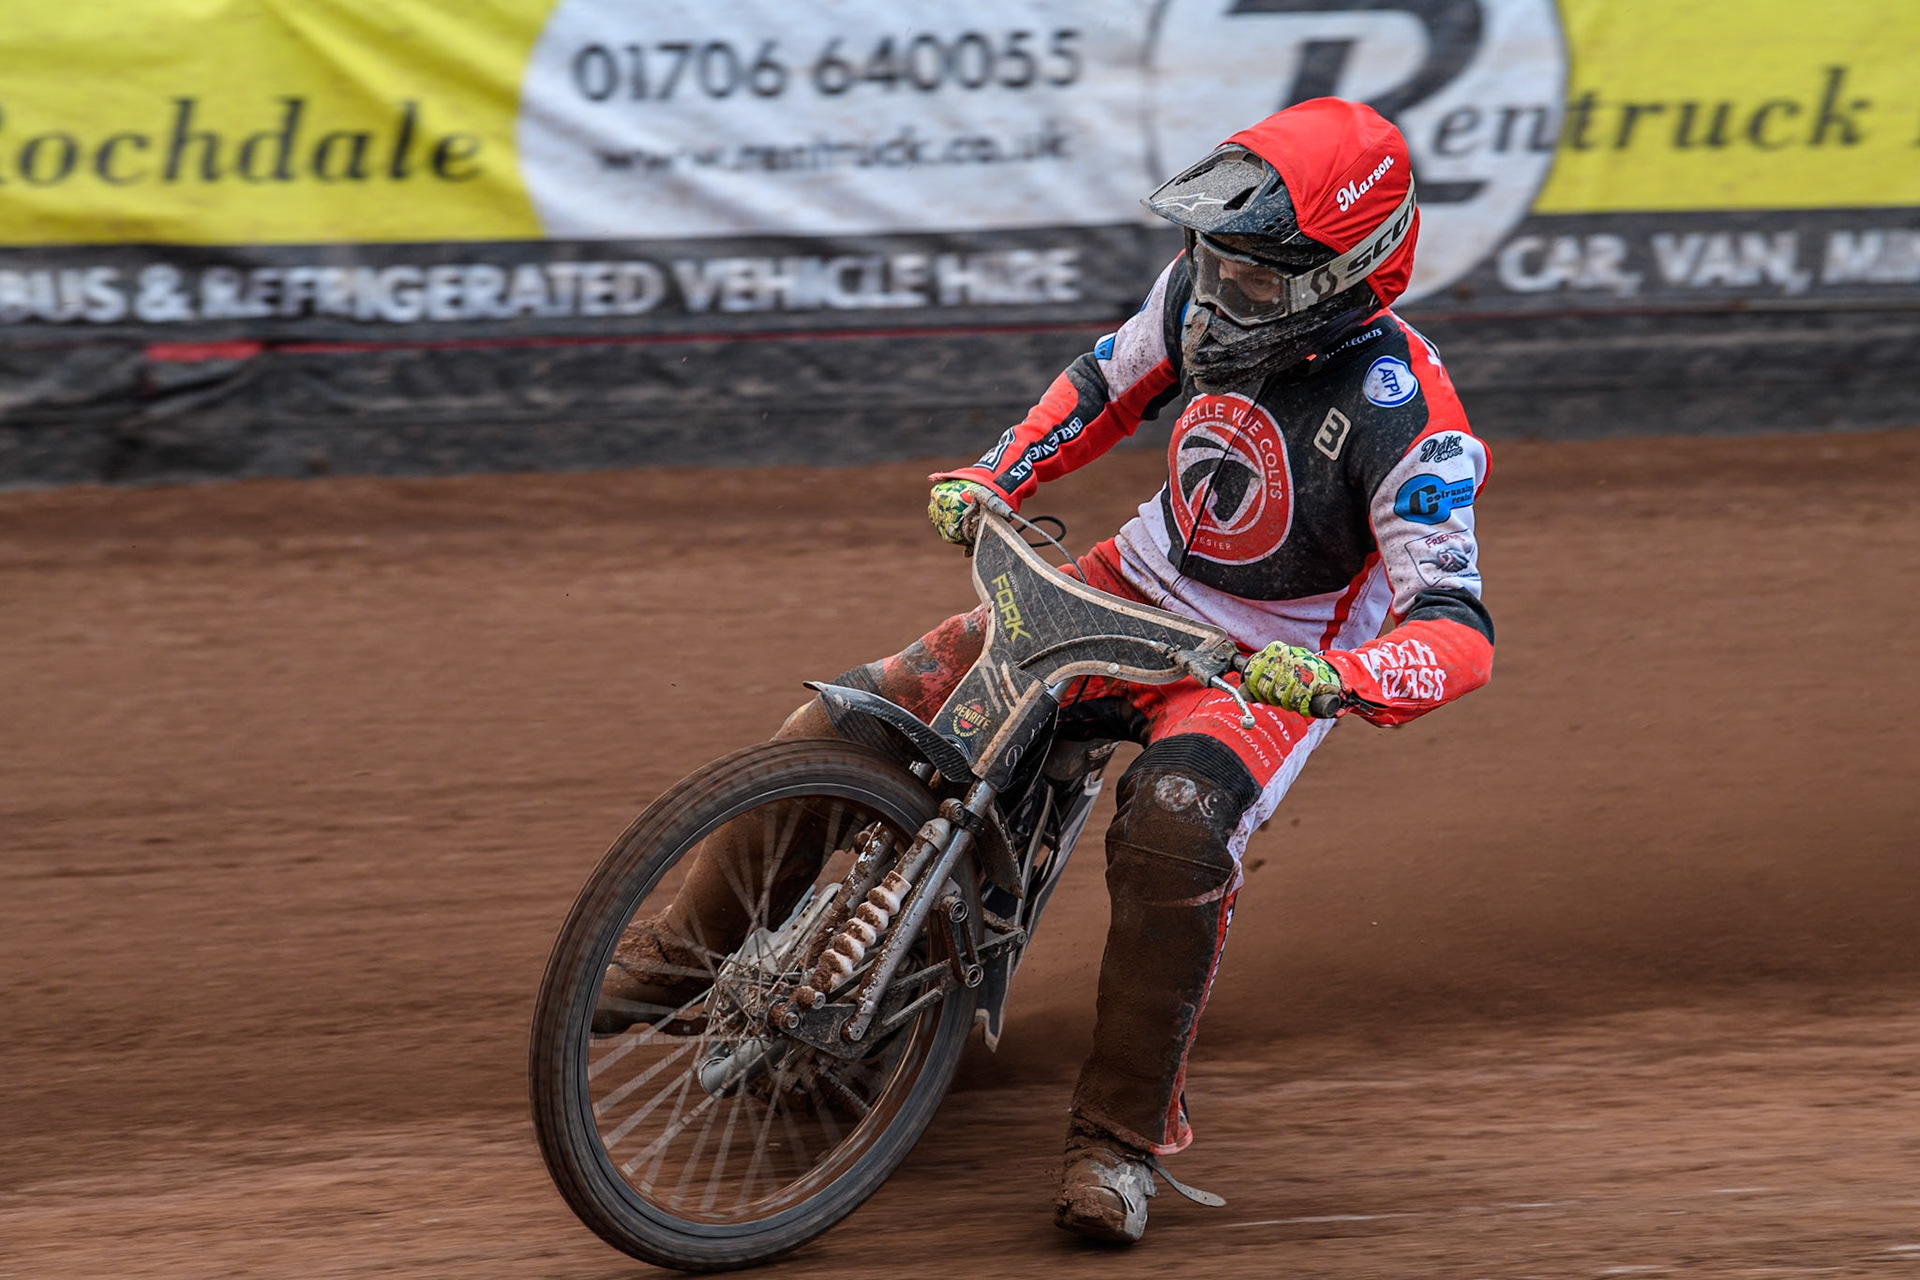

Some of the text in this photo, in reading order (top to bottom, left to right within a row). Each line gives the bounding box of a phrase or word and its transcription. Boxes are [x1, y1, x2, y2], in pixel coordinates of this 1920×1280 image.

[572, 30, 1084, 101] 01706 640055
[0, 96, 482, 187] ochdale
[1336, 155, 1395, 212] Marson
[135, 263, 192, 322] &
[202, 259, 664, 320] REFRIGERATED
[670, 255, 928, 311] VEHICLE
[1649, 231, 1812, 294] VAN,
[1378, 367, 1403, 397] ATPI
[1181, 402, 1287, 500] BELLE VUE COLTS
[991, 573, 1032, 643] FORK
[1381, 666, 1447, 702] CLASS
[952, 702, 991, 730] PENRITE
[1267, 711, 1290, 742] DAD
